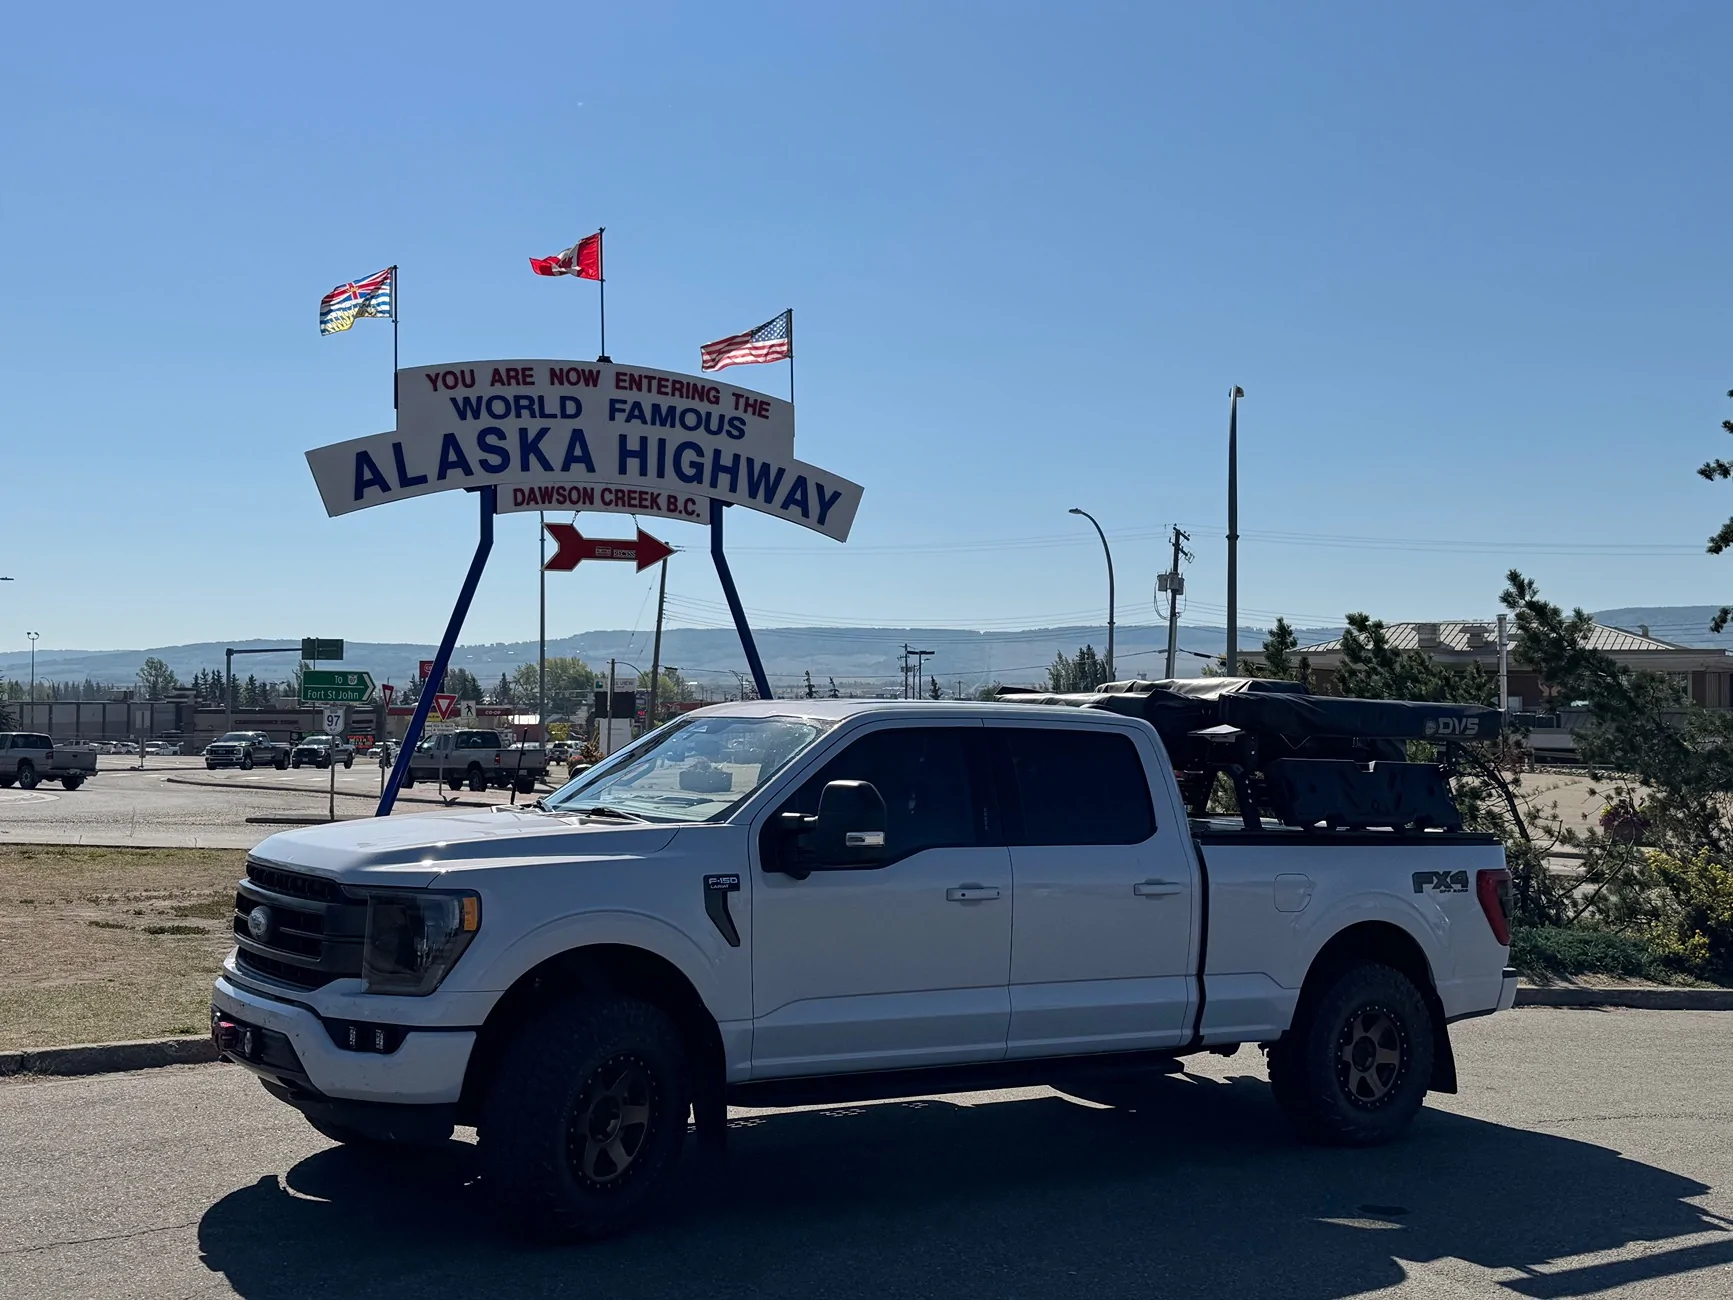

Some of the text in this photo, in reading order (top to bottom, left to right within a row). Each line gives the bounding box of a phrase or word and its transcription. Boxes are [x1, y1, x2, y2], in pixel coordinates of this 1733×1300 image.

[425, 367, 771, 420] YOU ARE NOW ENTERING THE
[449, 394, 747, 440] WORLD FAMOUS
[354, 426, 843, 526] ALASKA HIGHWAY
[513, 485, 701, 518] DAWSON CREEK B.C.
[334, 675, 343, 684] To
[307, 689, 359, 699] Fort St John
[326, 714, 341, 727] 97
[1411, 870, 1469, 894] FX4
